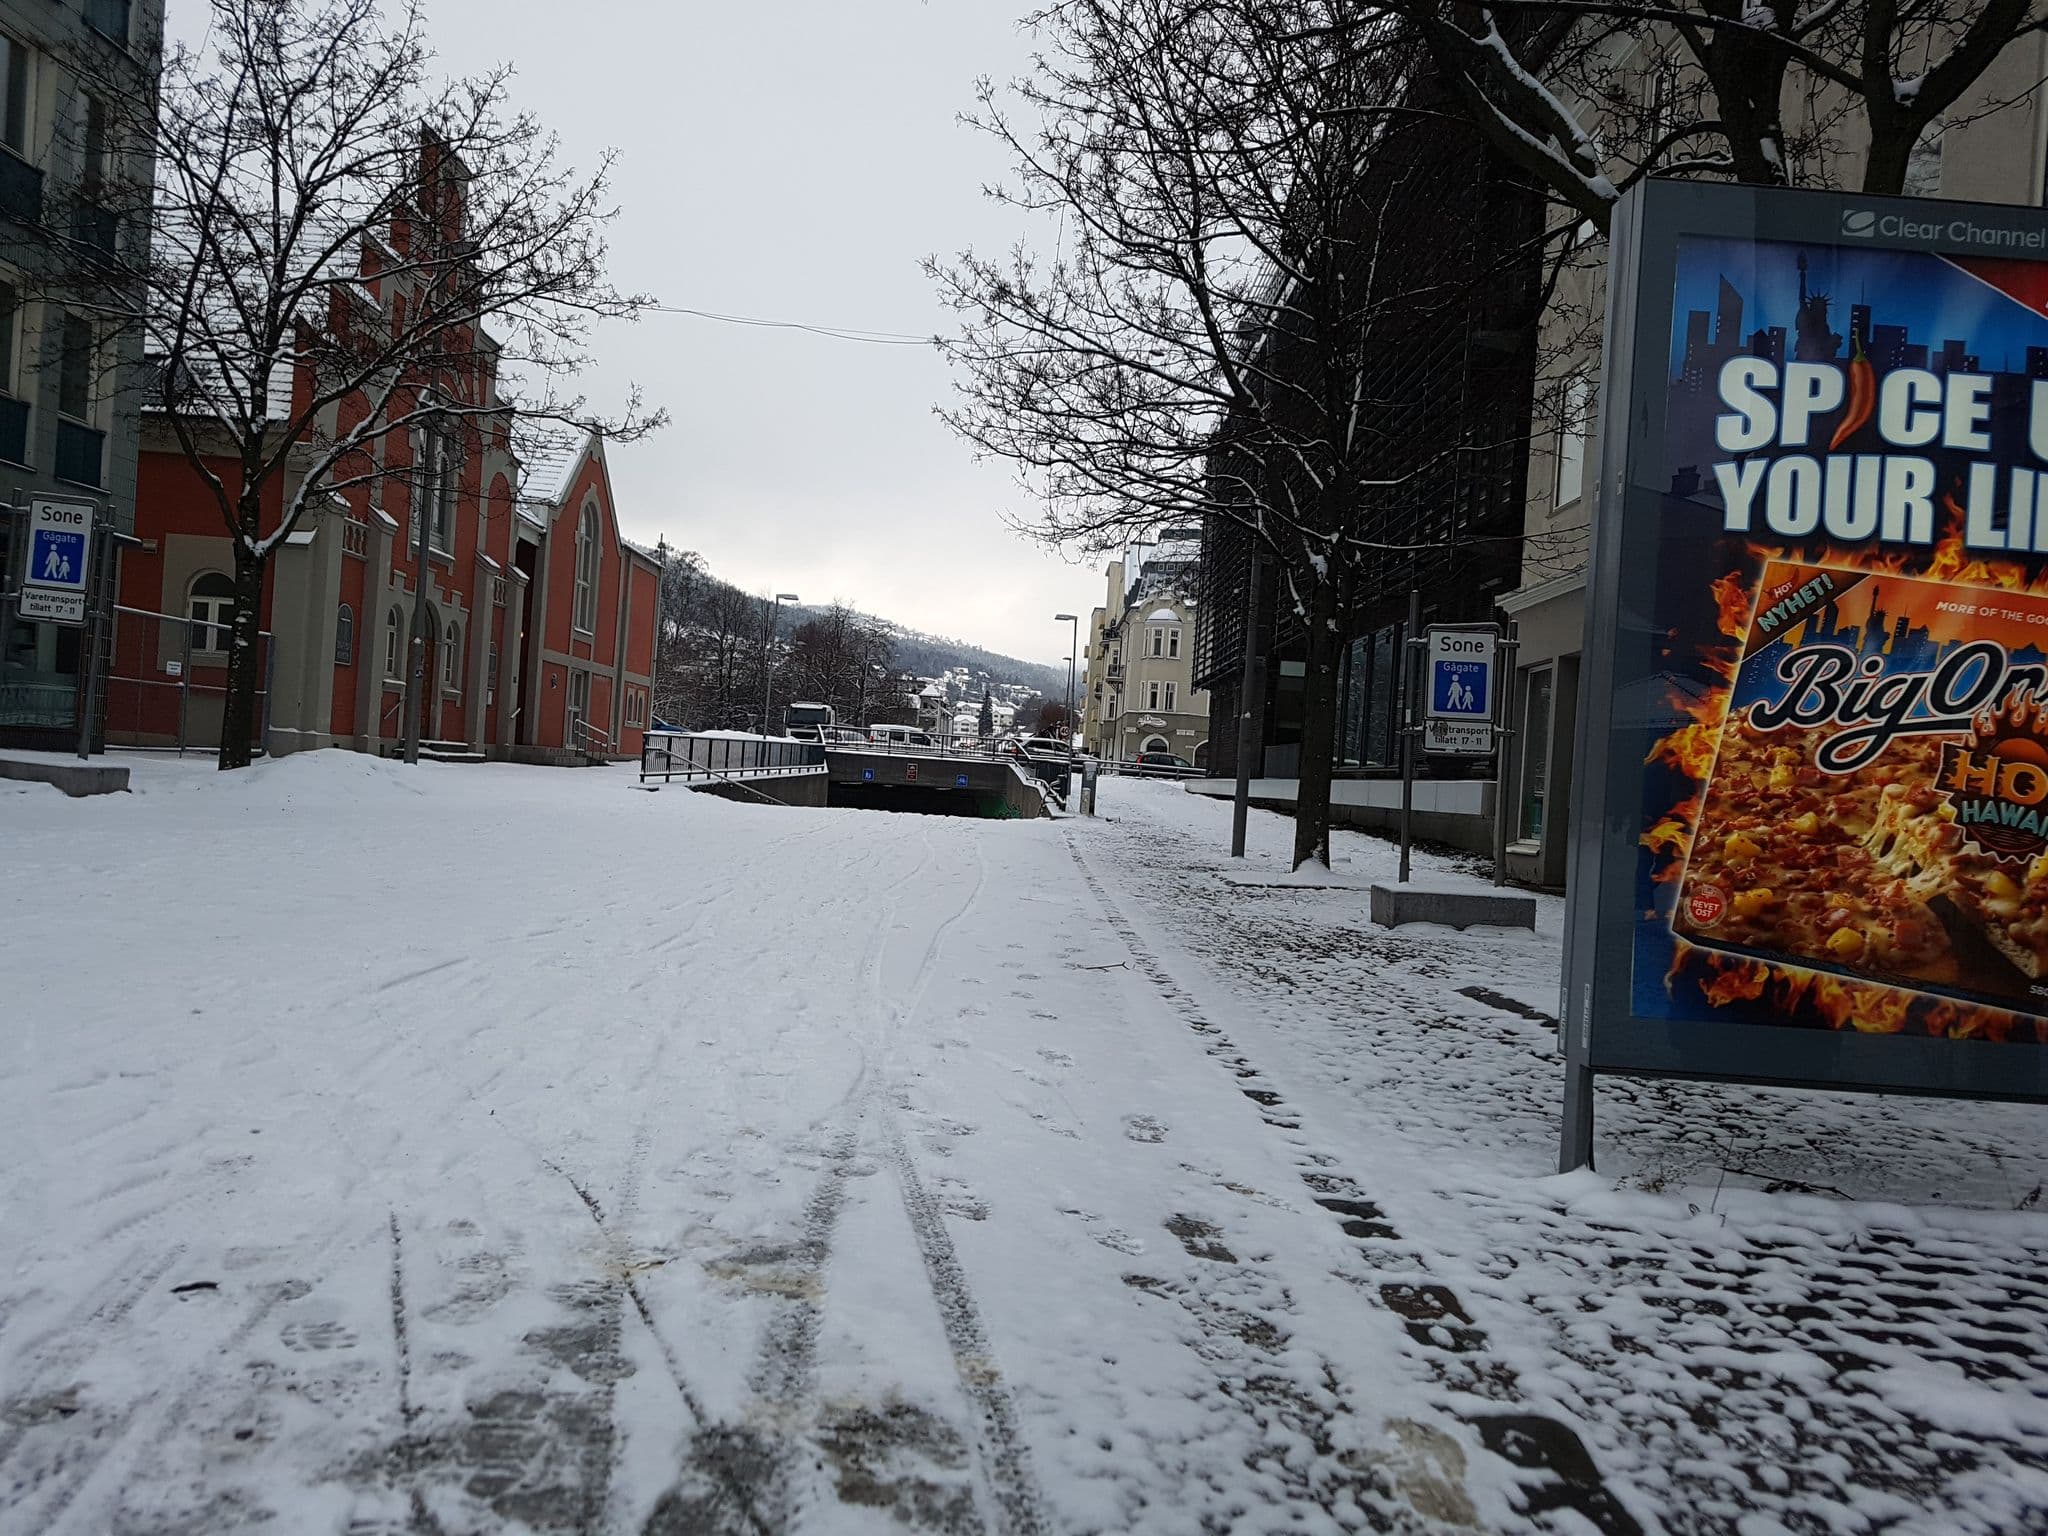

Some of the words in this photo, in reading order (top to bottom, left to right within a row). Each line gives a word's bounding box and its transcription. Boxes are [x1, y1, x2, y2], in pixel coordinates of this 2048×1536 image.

[1879, 216, 1943, 240] Clear
[1948, 221, 2047, 248] Channel
[1713, 455, 1937, 545] YOUR
[41, 506, 83, 524] Sone
[43, 531, 77, 543] Gågate
[1774, 582, 1792, 598] HOT
[24, 592, 82, 605] Varetransport
[1757, 573, 1833, 632] NYHET!
[30, 603, 51, 612] tillatt
[1936, 601, 1977, 614] MORE
[1980, 607, 1998, 616] OF
[2001, 609, 2025, 621] THE
[1440, 637, 1484, 653] Sone
[1443, 662, 1479, 673] Gågate
[1749, 643, 1929, 775] Big
[1429, 724, 1489, 735] Vtransport
[1435, 736, 1457, 744] tillatt
[1692, 900, 1720, 911] REVET
[1695, 909, 1712, 917] OST
